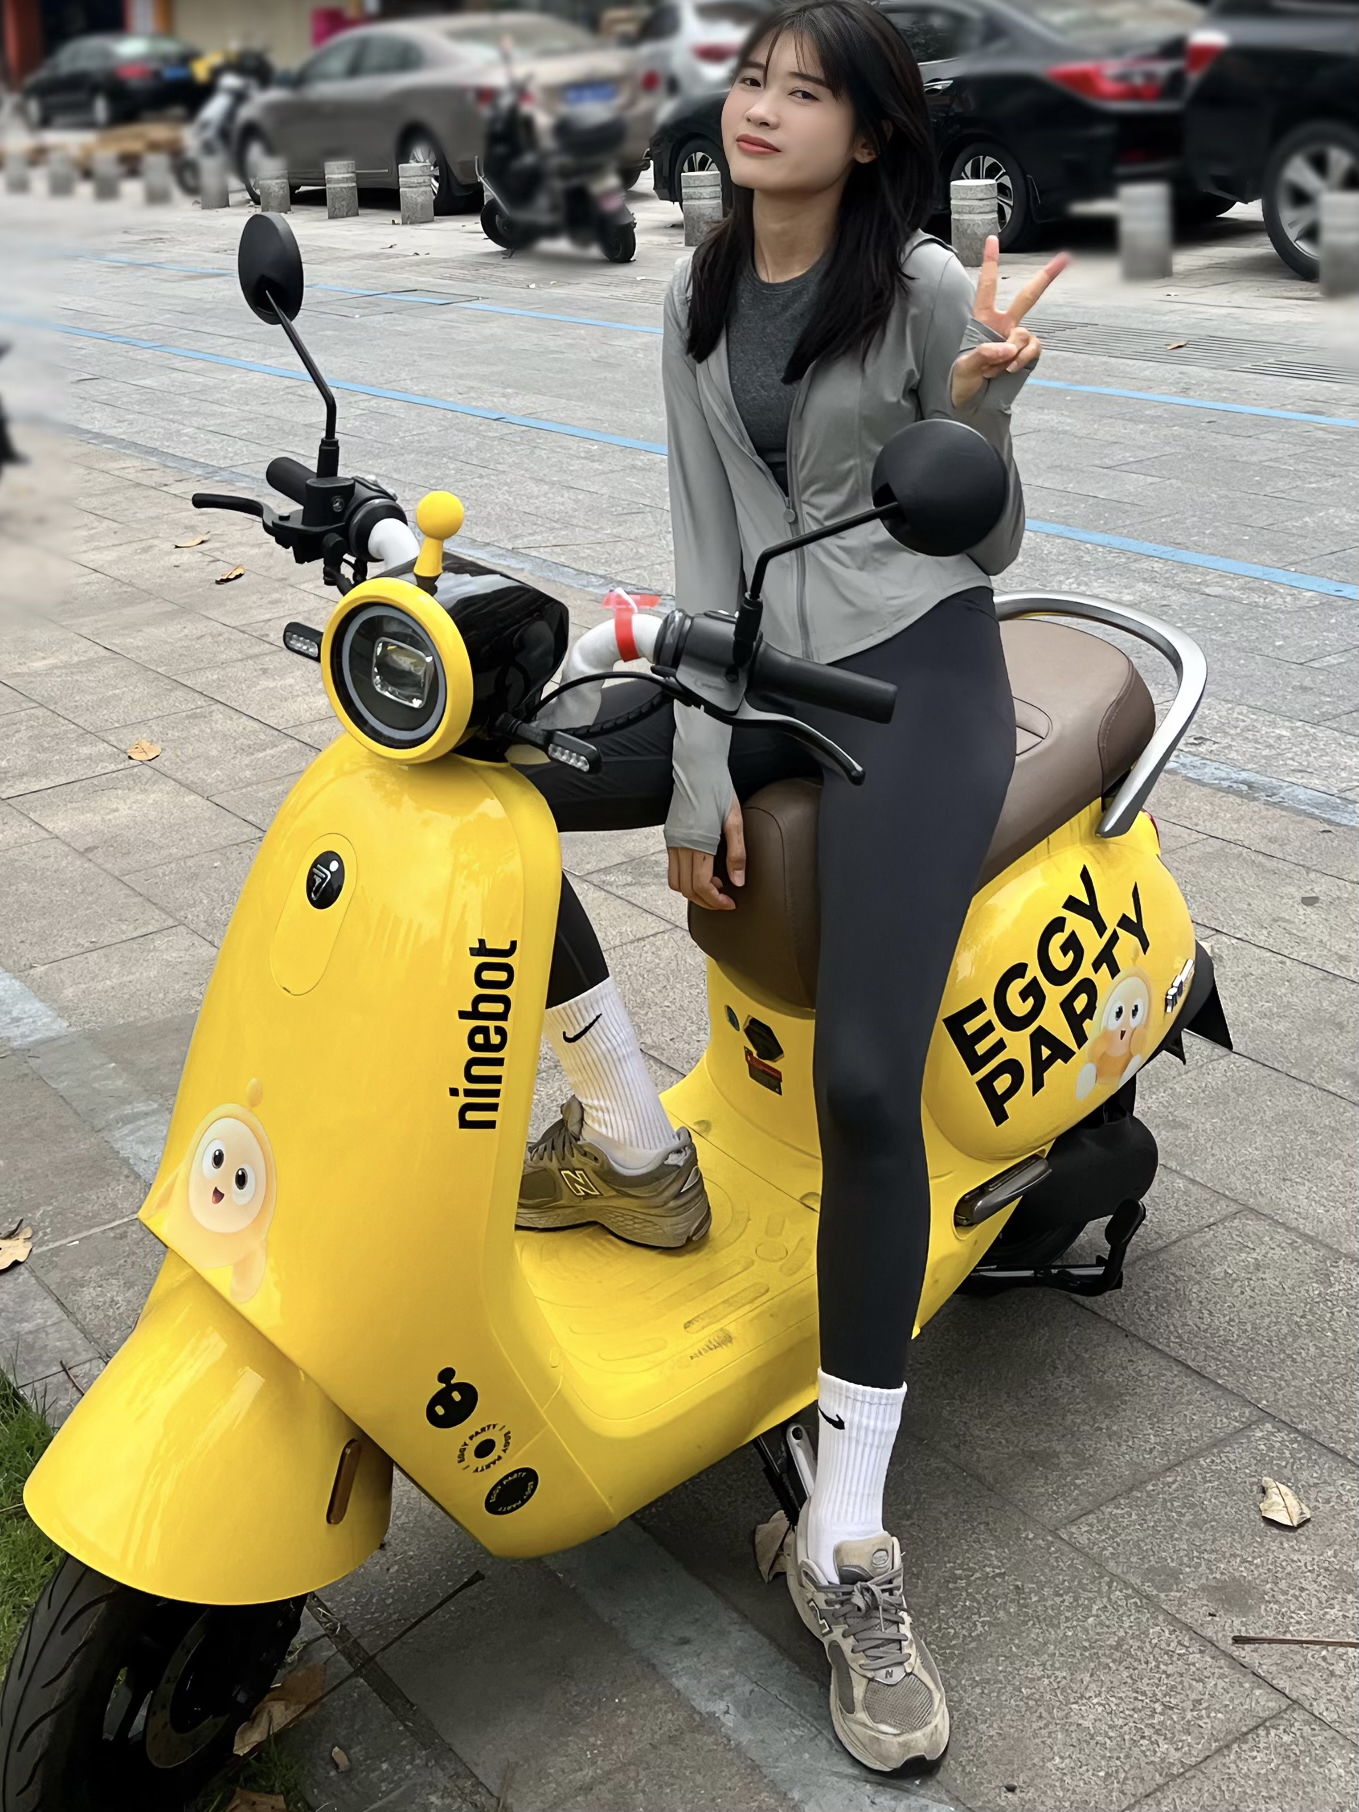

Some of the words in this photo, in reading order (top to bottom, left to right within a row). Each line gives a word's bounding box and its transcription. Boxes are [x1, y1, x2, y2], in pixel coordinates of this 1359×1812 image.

[449, 938, 518, 1130] ninebot
[942, 864, 1107, 1076] EGGY
[975, 881, 1150, 1127] PARTY
[558, 1167, 604, 1196] N
